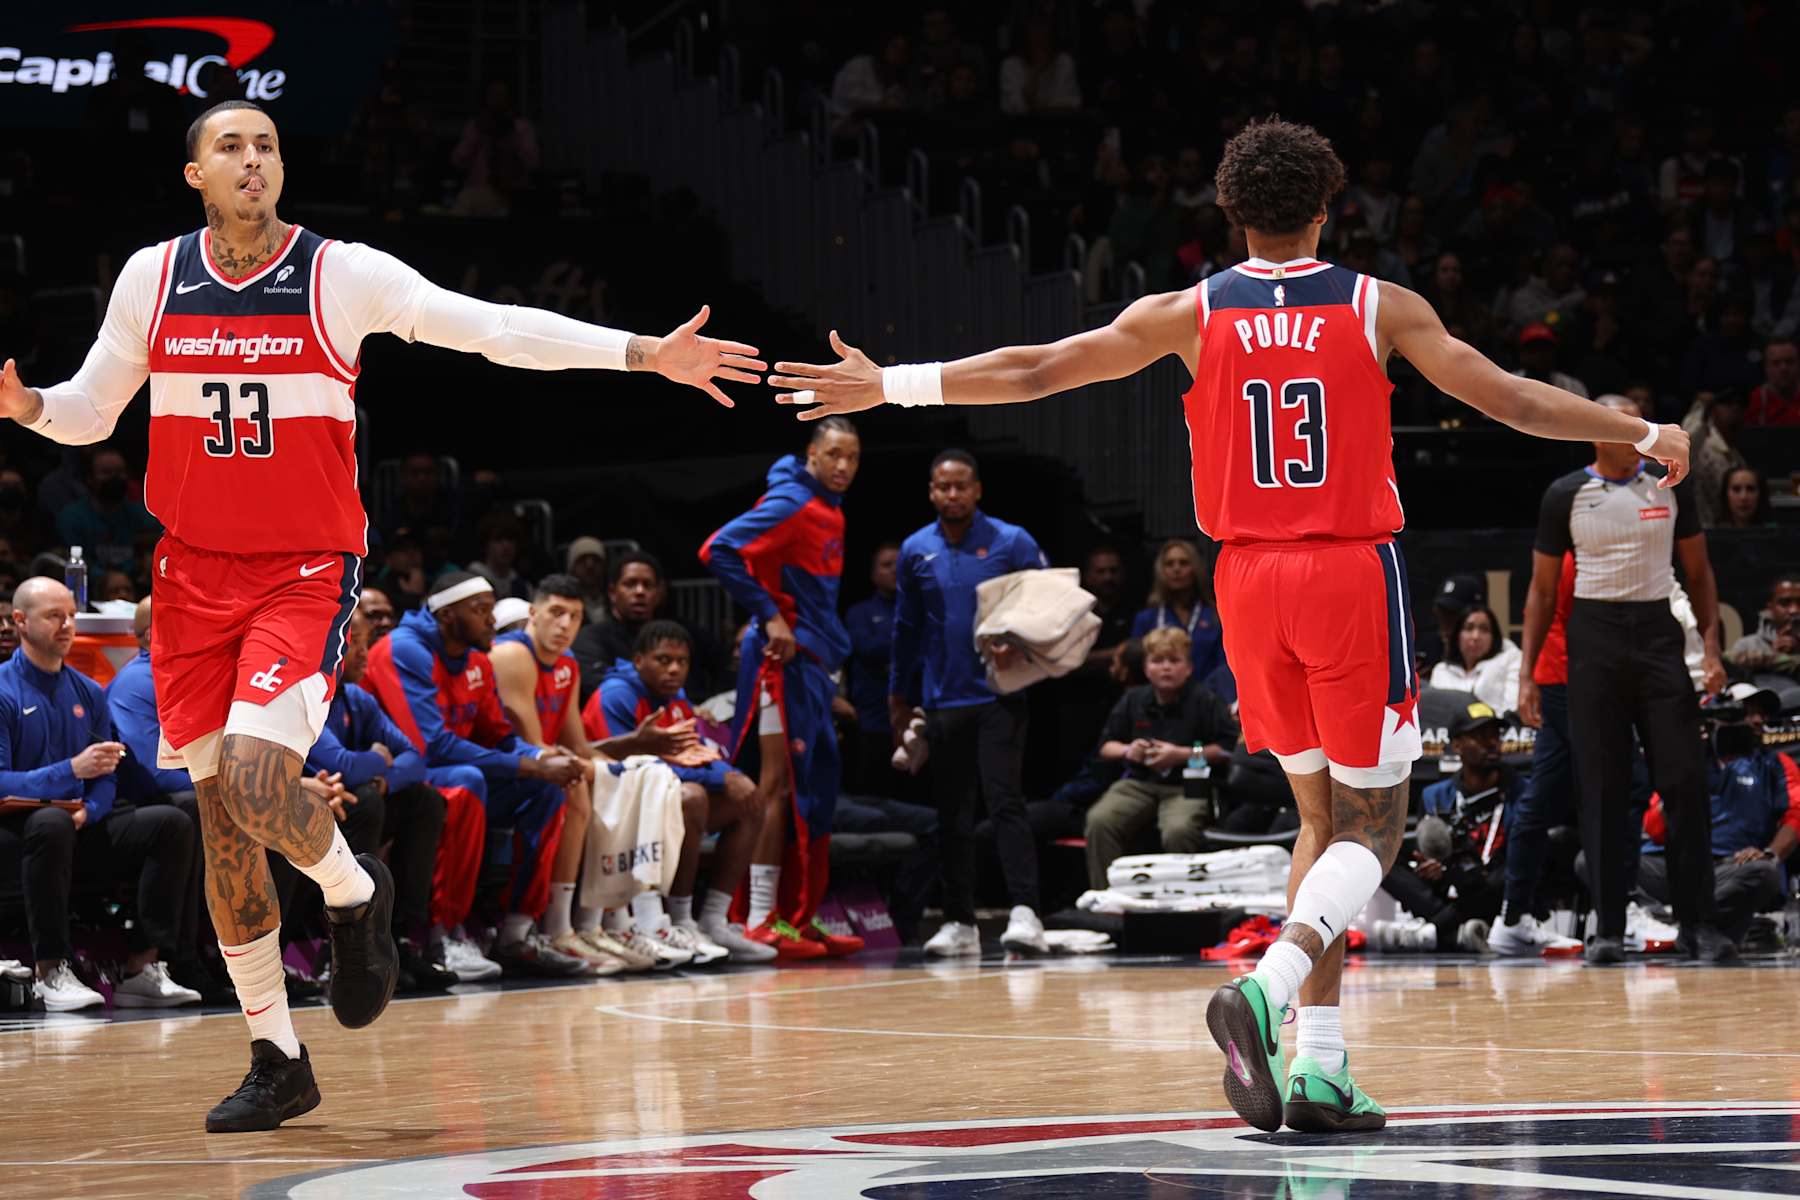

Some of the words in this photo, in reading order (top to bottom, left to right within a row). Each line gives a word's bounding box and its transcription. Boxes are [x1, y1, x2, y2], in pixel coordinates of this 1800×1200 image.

[0, 47, 187, 93] Capial
[263, 286, 303, 294] Robinhood
[164, 328, 304, 363] washington
[1234, 312, 1326, 354] POOLE
[202, 382, 275, 458] 33
[1242, 377, 1328, 488] 13
